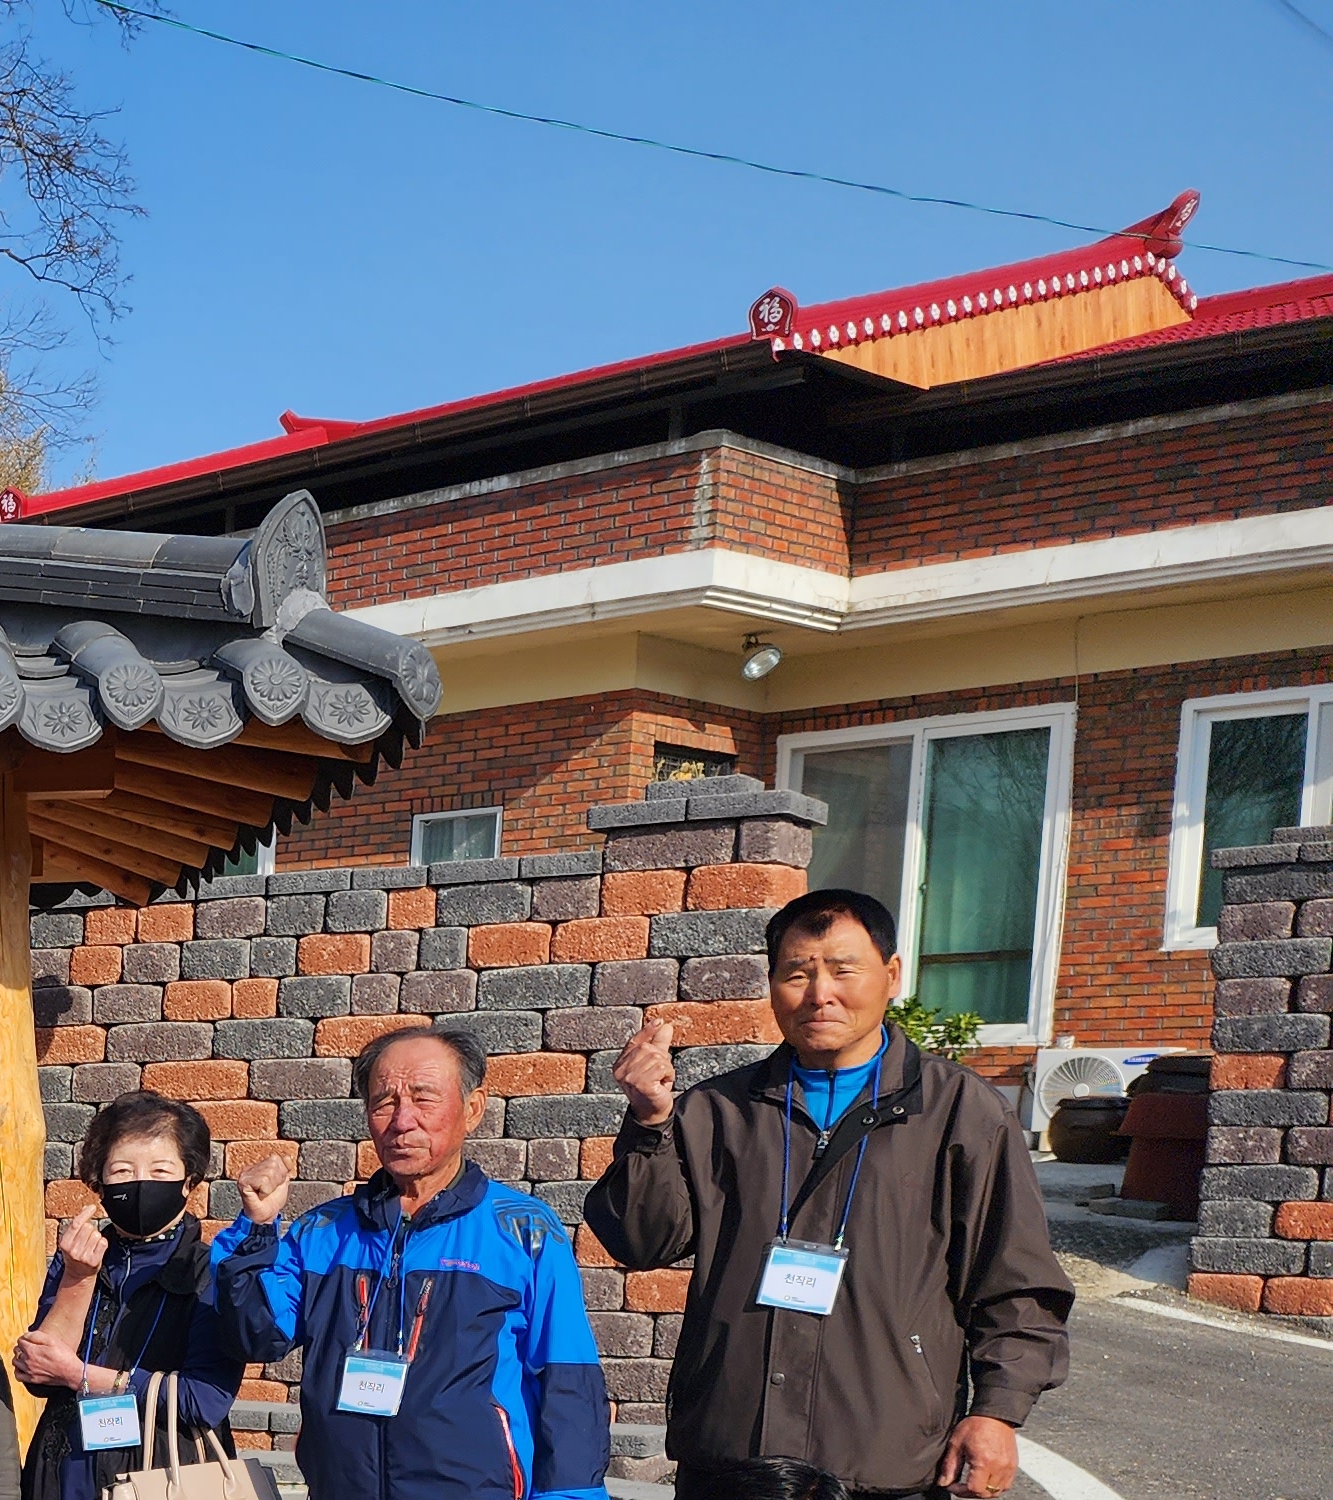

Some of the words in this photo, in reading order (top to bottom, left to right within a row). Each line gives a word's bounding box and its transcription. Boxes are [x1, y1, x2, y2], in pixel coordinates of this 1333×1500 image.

[784, 1273, 817, 1288] 천작리
[359, 1380, 385, 1393] 천작리
[98, 1416, 123, 1428] 천작리
